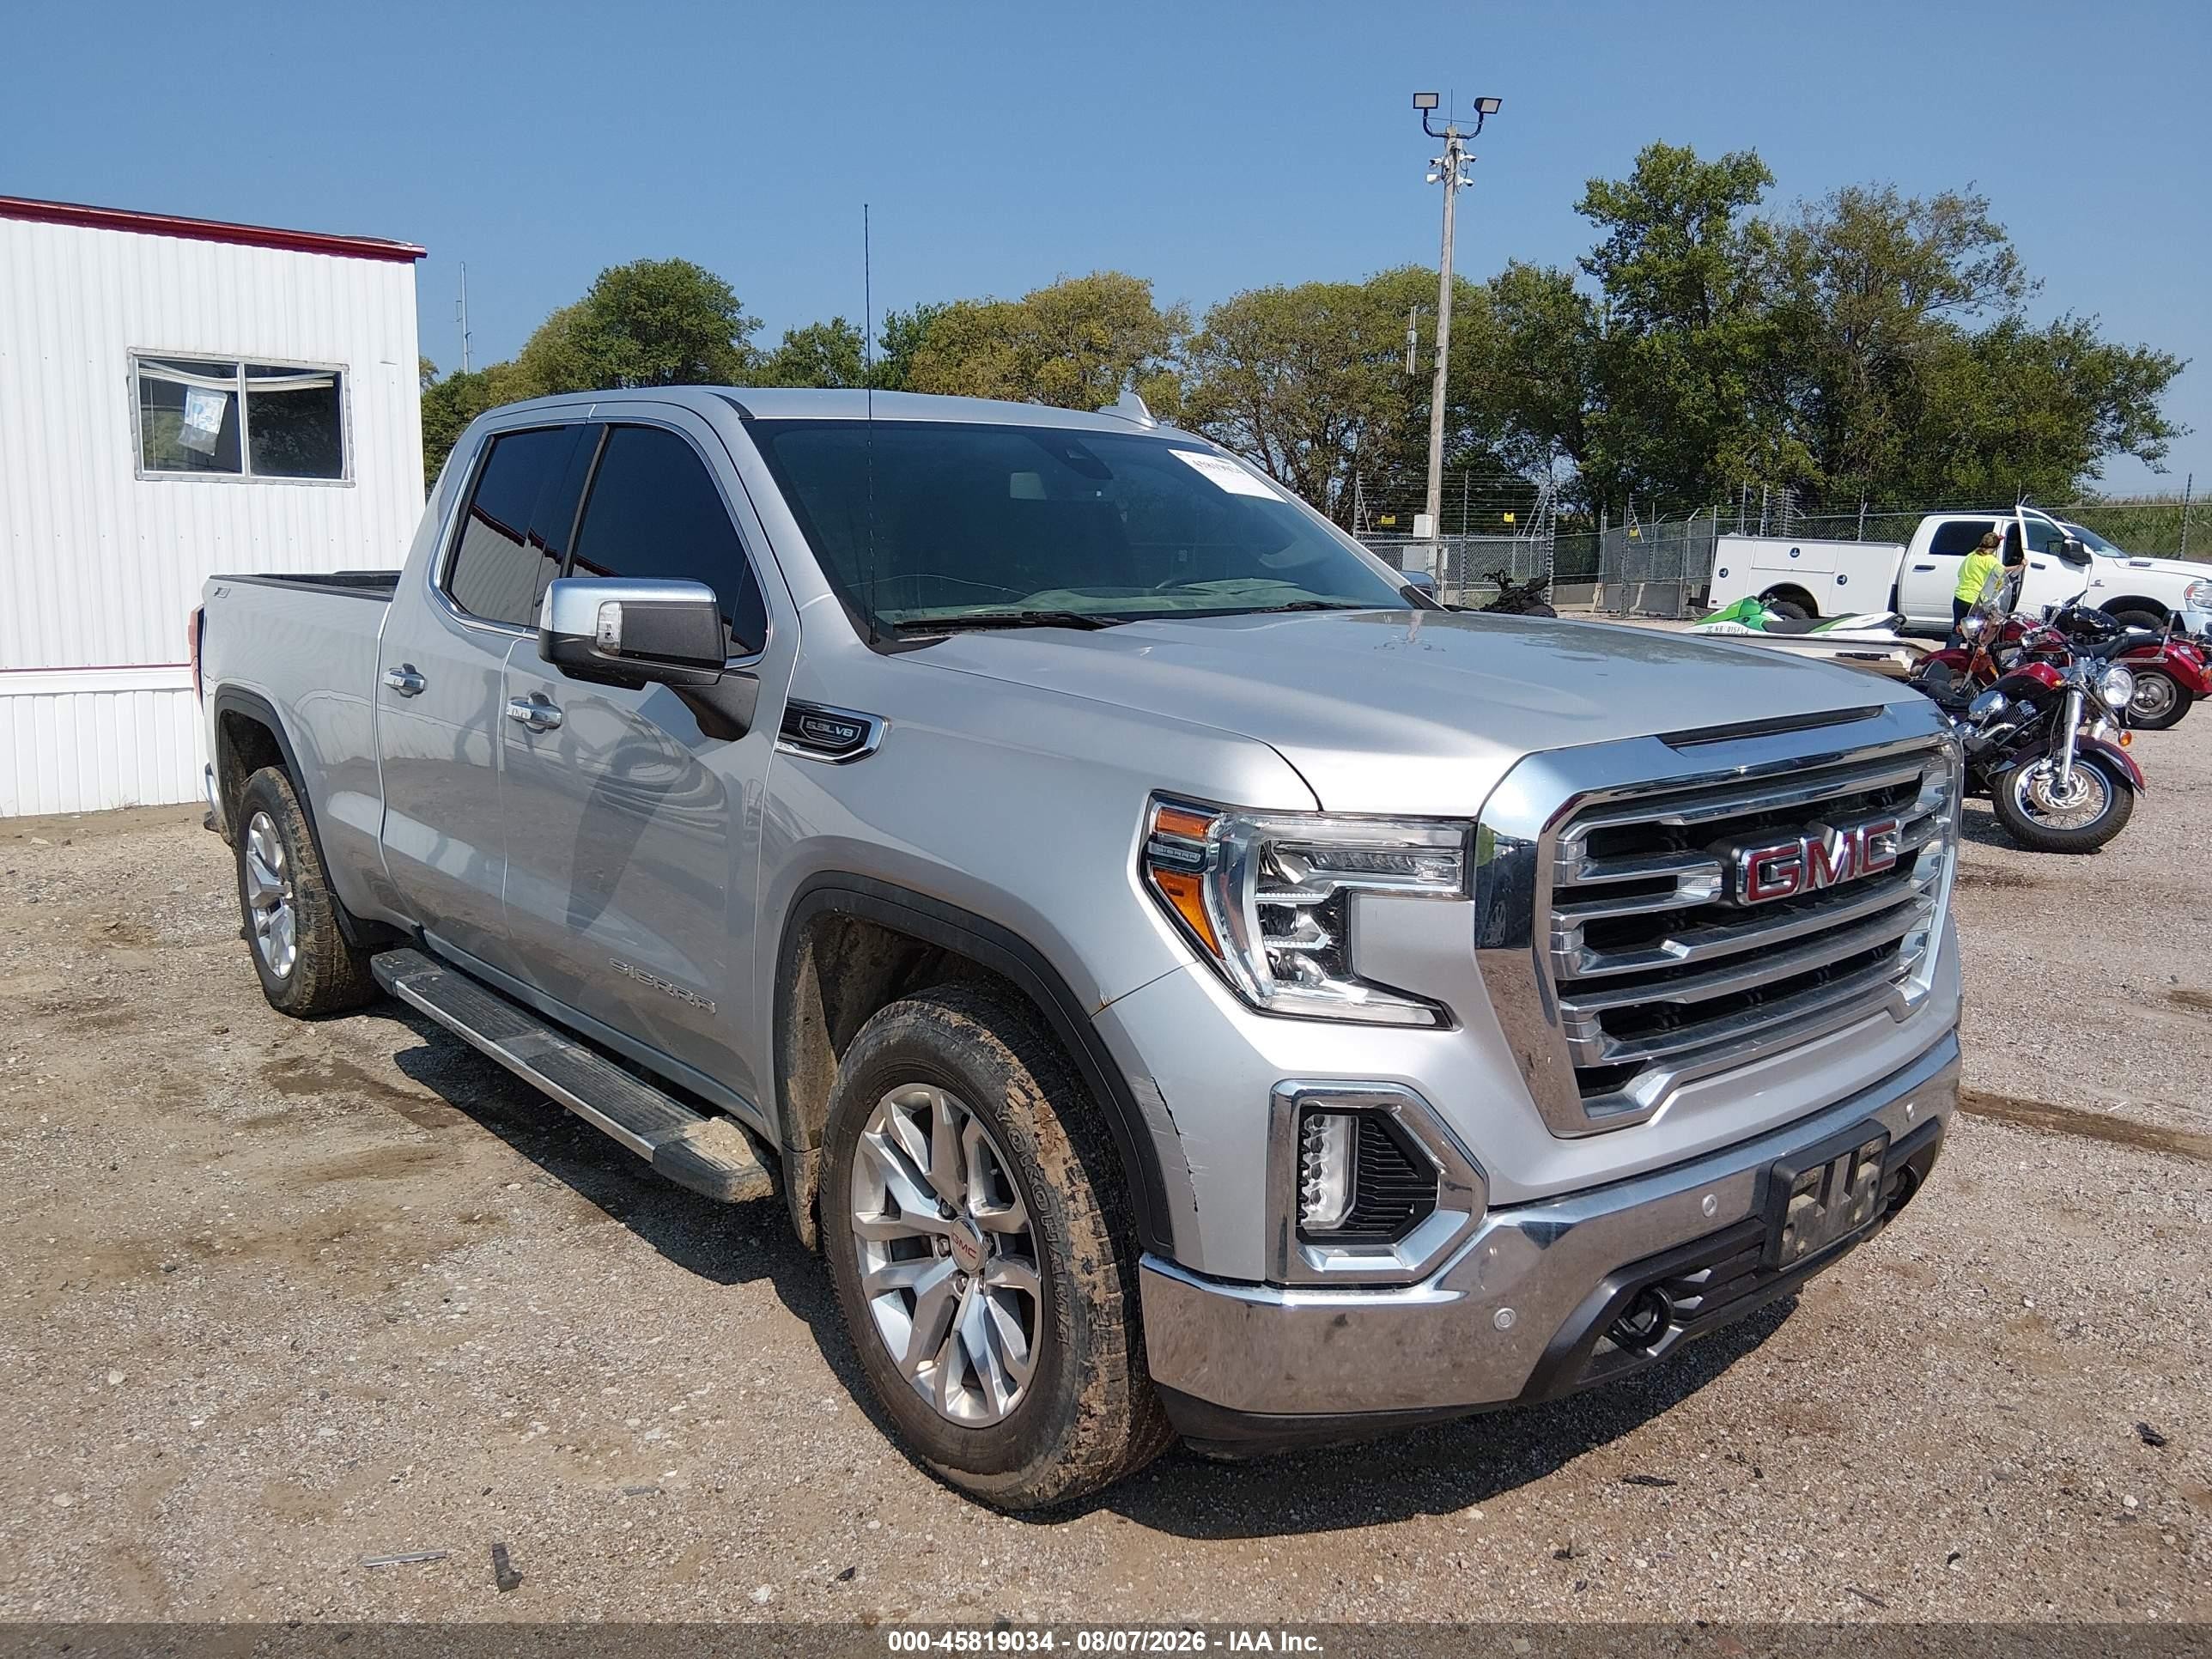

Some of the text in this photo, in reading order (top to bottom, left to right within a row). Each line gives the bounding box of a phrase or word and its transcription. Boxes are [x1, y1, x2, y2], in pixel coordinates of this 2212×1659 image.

[1737, 818, 1899, 906] GMC
[608, 957, 716, 1014] SIERRA
[952, 1232, 976, 1259] GMC
[994, 1099, 1071, 1344] YOKOHAMA
